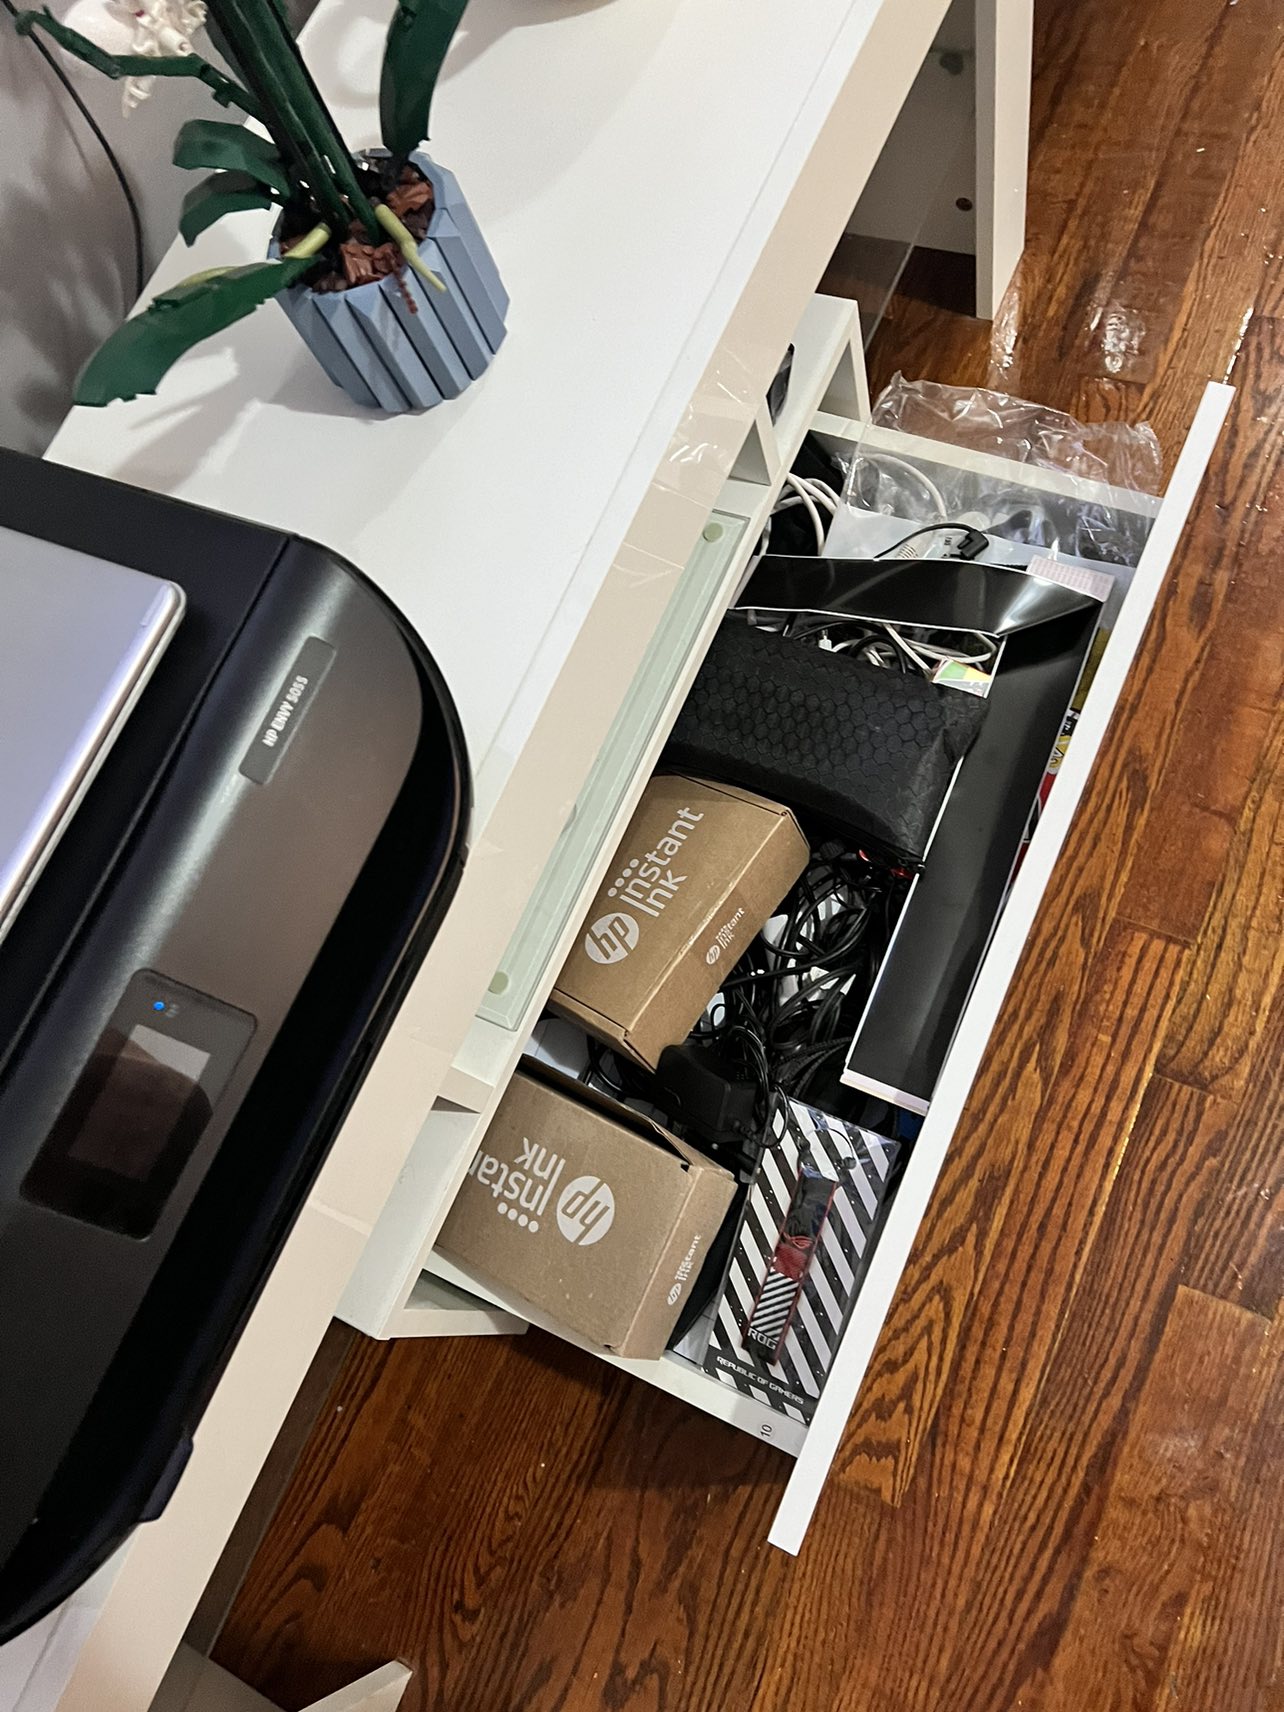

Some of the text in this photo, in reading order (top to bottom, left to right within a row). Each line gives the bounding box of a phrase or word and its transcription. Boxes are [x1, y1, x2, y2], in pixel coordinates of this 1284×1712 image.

[262, 728, 278, 747] HP
[270, 701, 294, 731] ENVY
[619, 807, 704, 905] Instant
[637, 869, 688, 917] Ink
[585, 912, 640, 964] hp
[706, 945, 720, 964] hp
[514, 1137, 566, 1184] Ink
[556, 1175, 615, 1246] hp
[747, 1327, 778, 1350] ROG
[716, 1355, 804, 1405] REPUBLIC OF GAMERS
